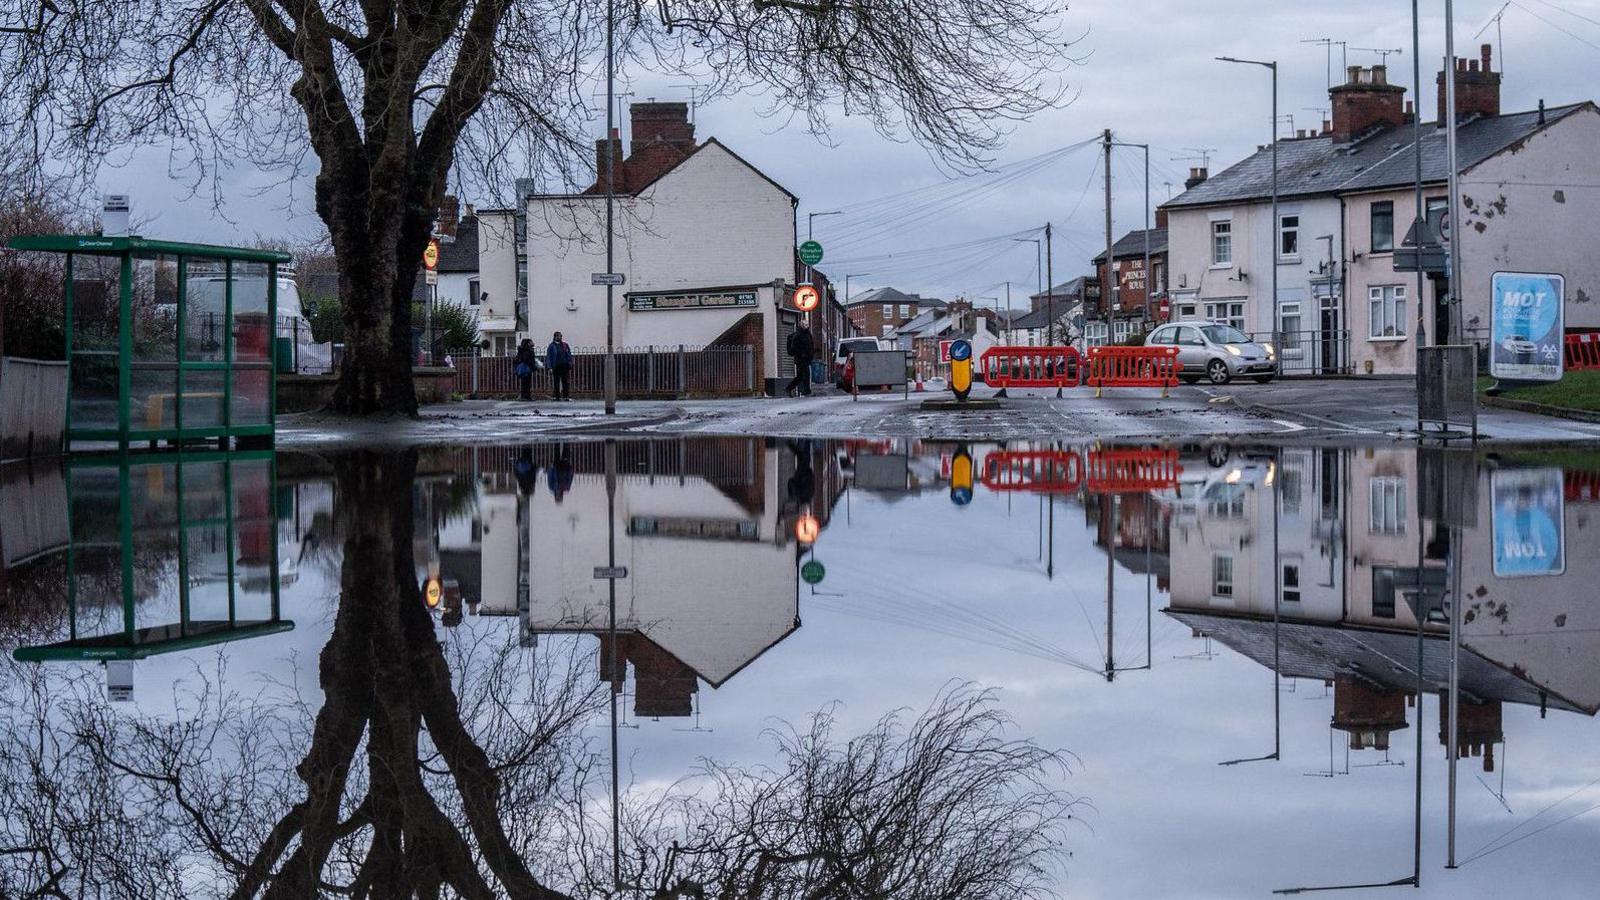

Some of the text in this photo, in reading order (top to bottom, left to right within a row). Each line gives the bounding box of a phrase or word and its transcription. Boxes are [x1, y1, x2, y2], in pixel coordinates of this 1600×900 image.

[1131, 260, 1143, 269] THE
[1129, 280, 1145, 290] ROYAL
[1503, 291, 1547, 307] MOT
